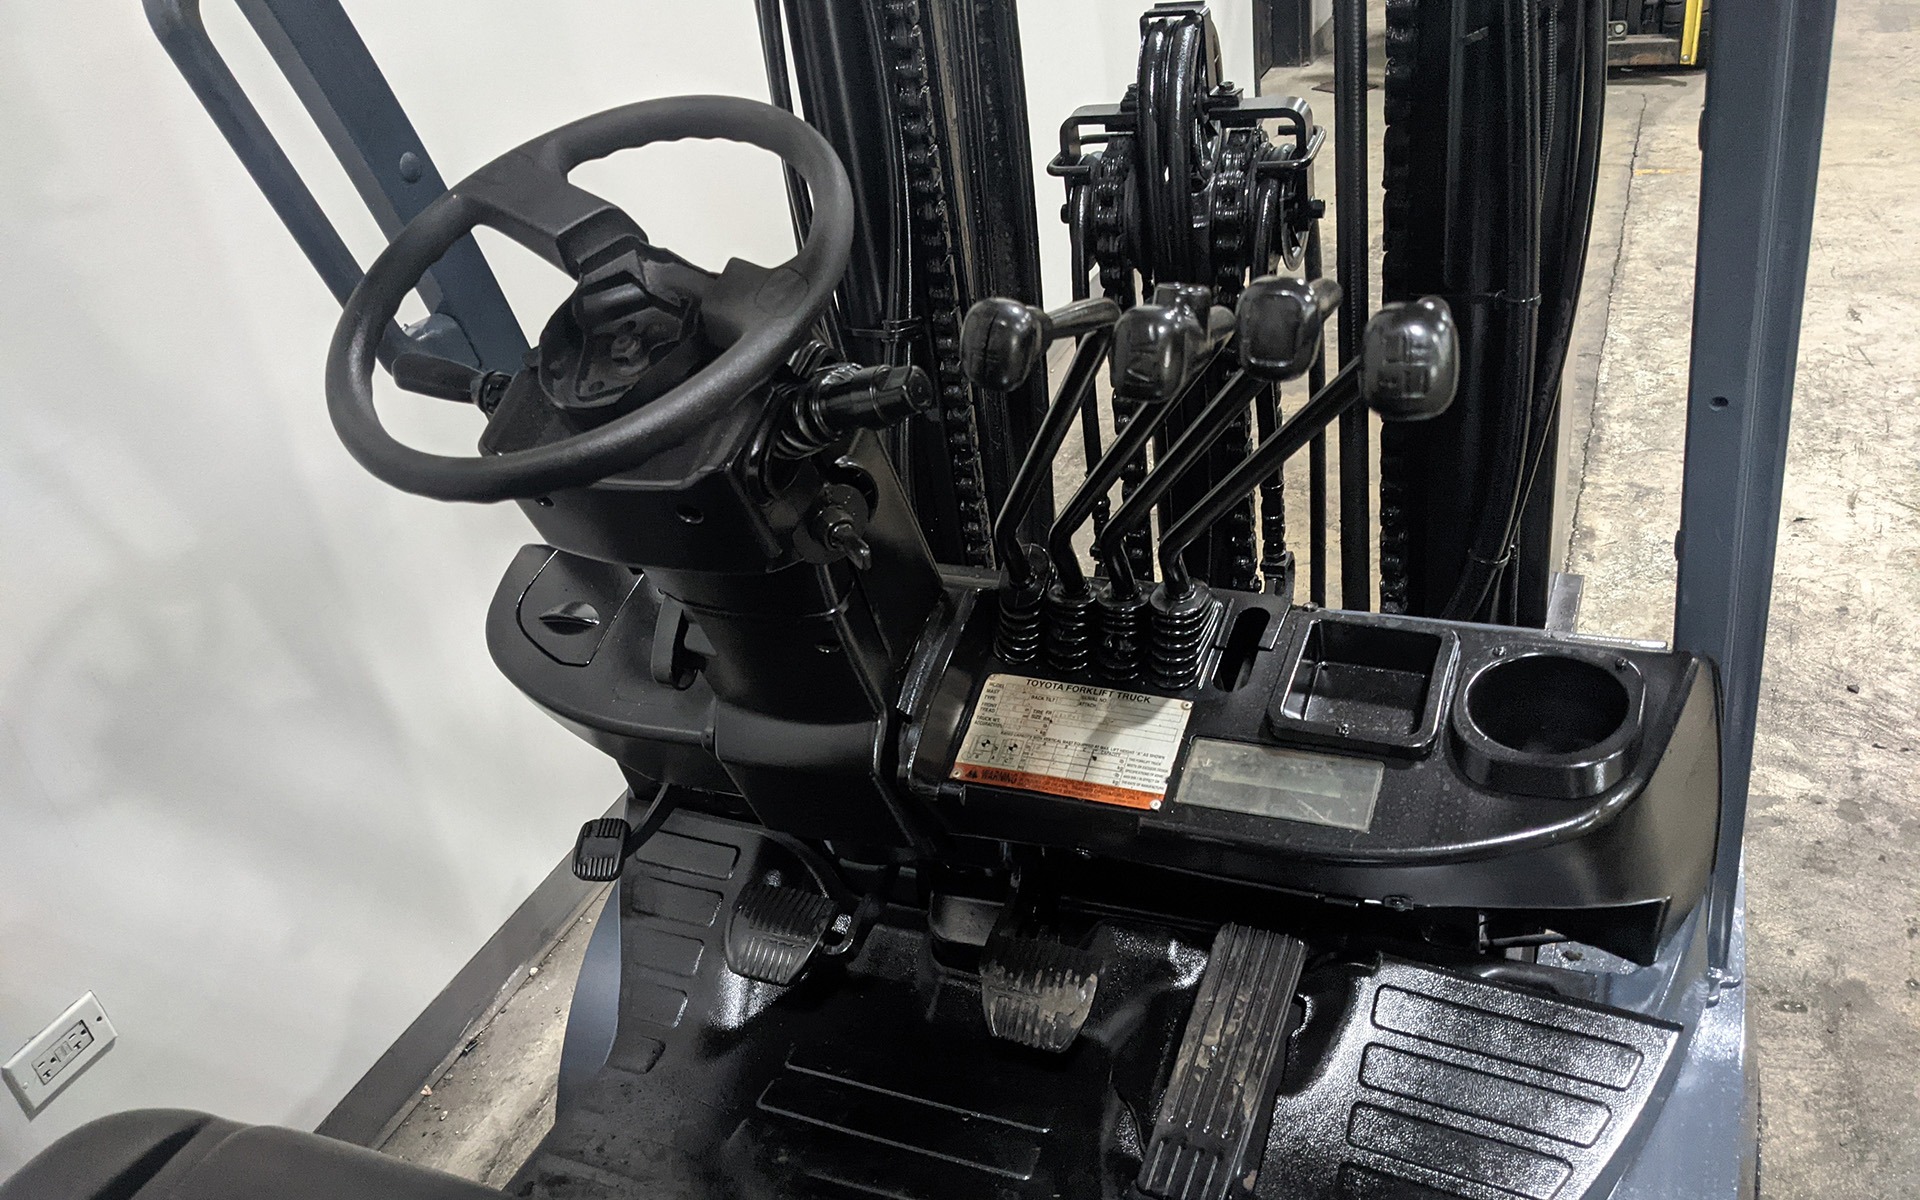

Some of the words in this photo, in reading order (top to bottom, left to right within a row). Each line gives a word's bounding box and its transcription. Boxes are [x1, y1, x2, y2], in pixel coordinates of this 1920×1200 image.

[1026, 679, 1064, 690] TOYOTA
[1066, 685, 1114, 697] FORKLIFT
[1117, 692, 1151, 703] TRUCK
[982, 770, 1017, 784] WARNING
